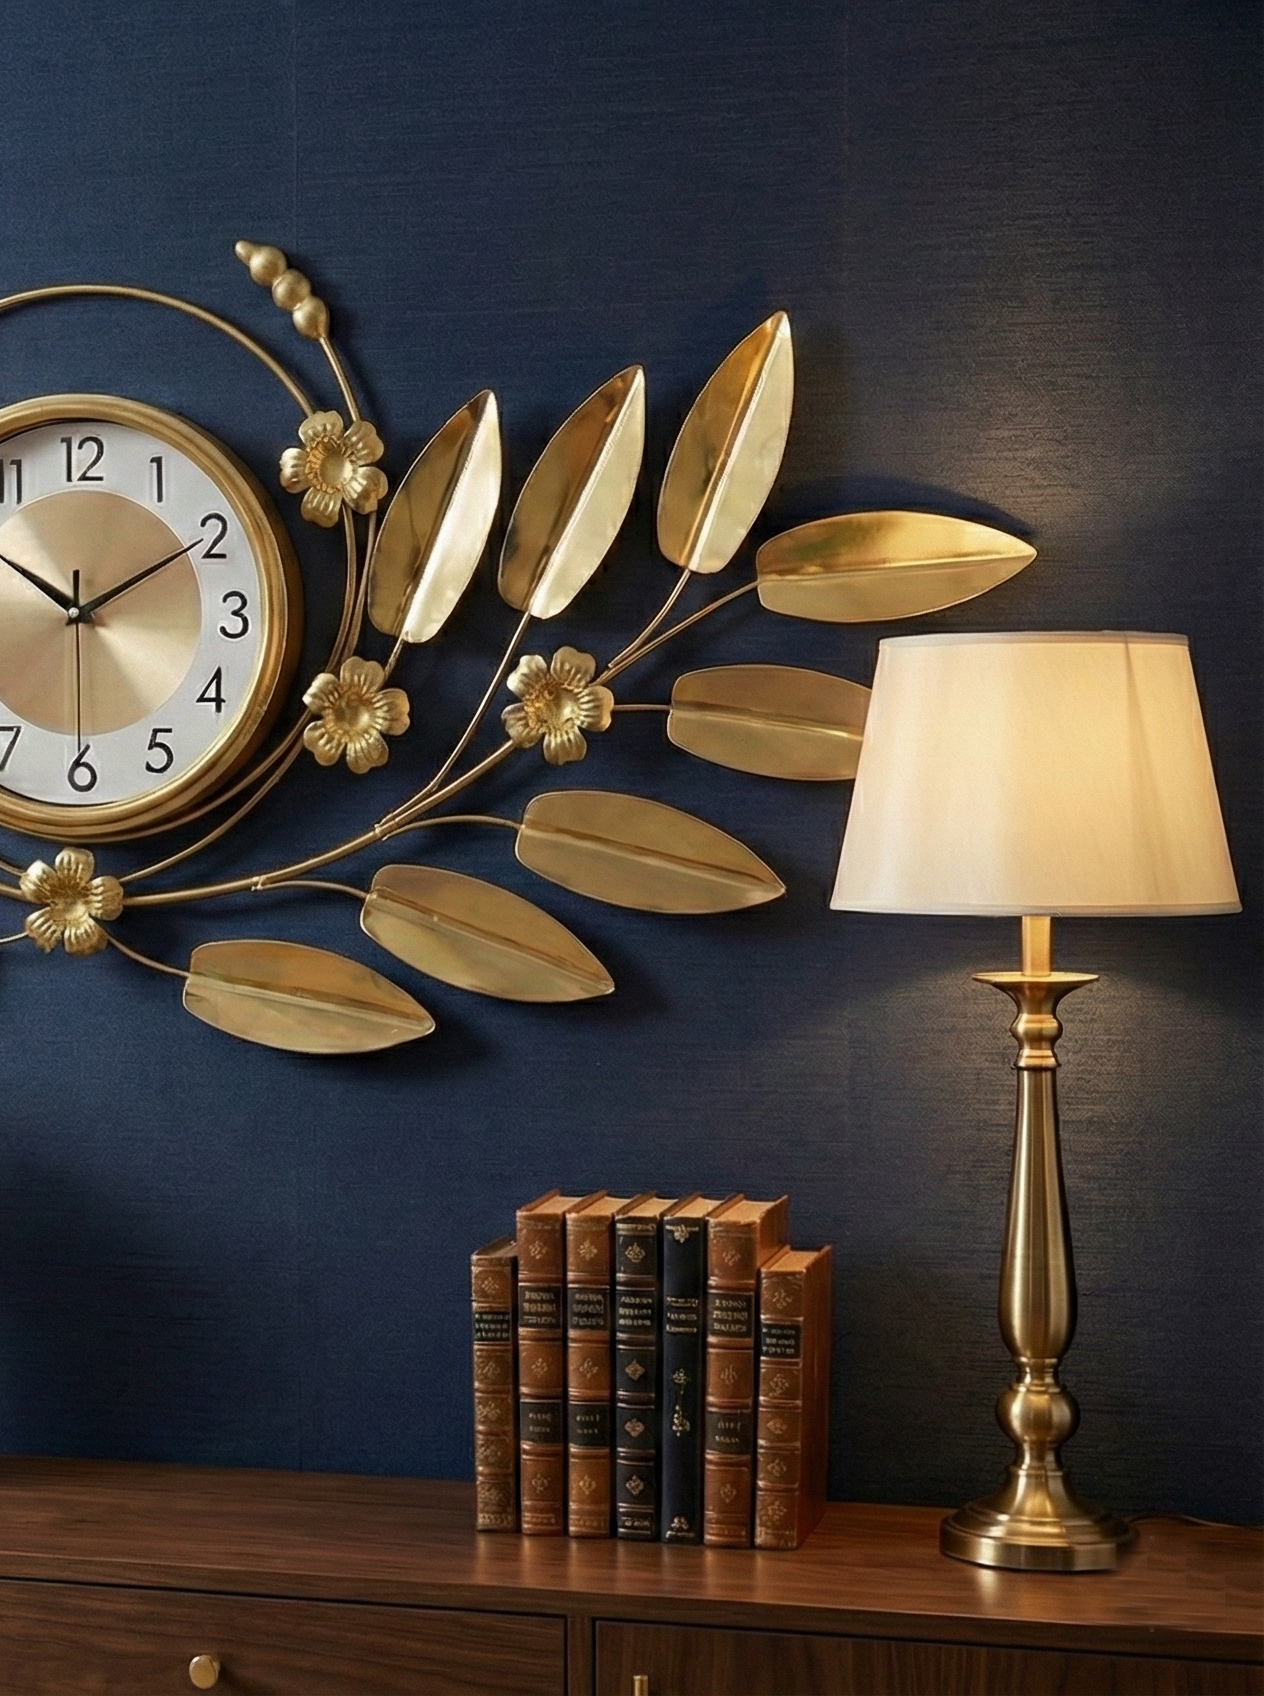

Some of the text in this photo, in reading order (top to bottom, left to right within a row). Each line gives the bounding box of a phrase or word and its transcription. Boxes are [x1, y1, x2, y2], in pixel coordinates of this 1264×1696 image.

[61, 436, 105, 482] 12
[149, 456, 164, 503] 1
[200, 513, 228, 559] 2
[219, 591, 249, 639] 3
[196, 667, 225, 713] 4
[68, 744, 97, 792] 6
[146, 728, 173, 774] 5
